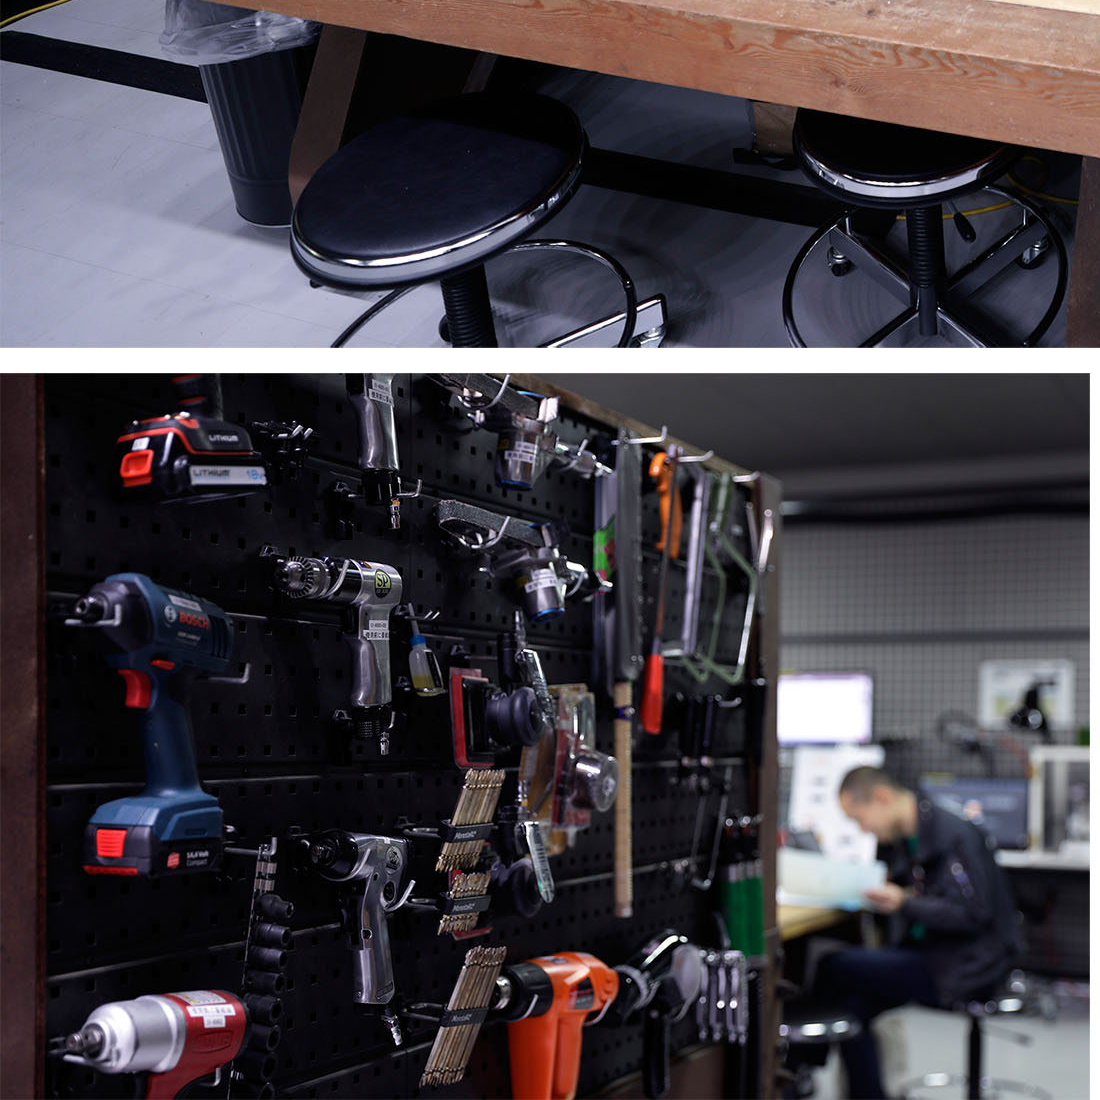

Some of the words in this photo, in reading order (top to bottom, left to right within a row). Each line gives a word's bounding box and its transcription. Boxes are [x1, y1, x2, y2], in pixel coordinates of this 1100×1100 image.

[209, 434, 239, 442] LITHIUM
[193, 469, 230, 477] LITHIUM
[376, 573, 388, 588] SP
[178, 611, 209, 630] BOSCH
